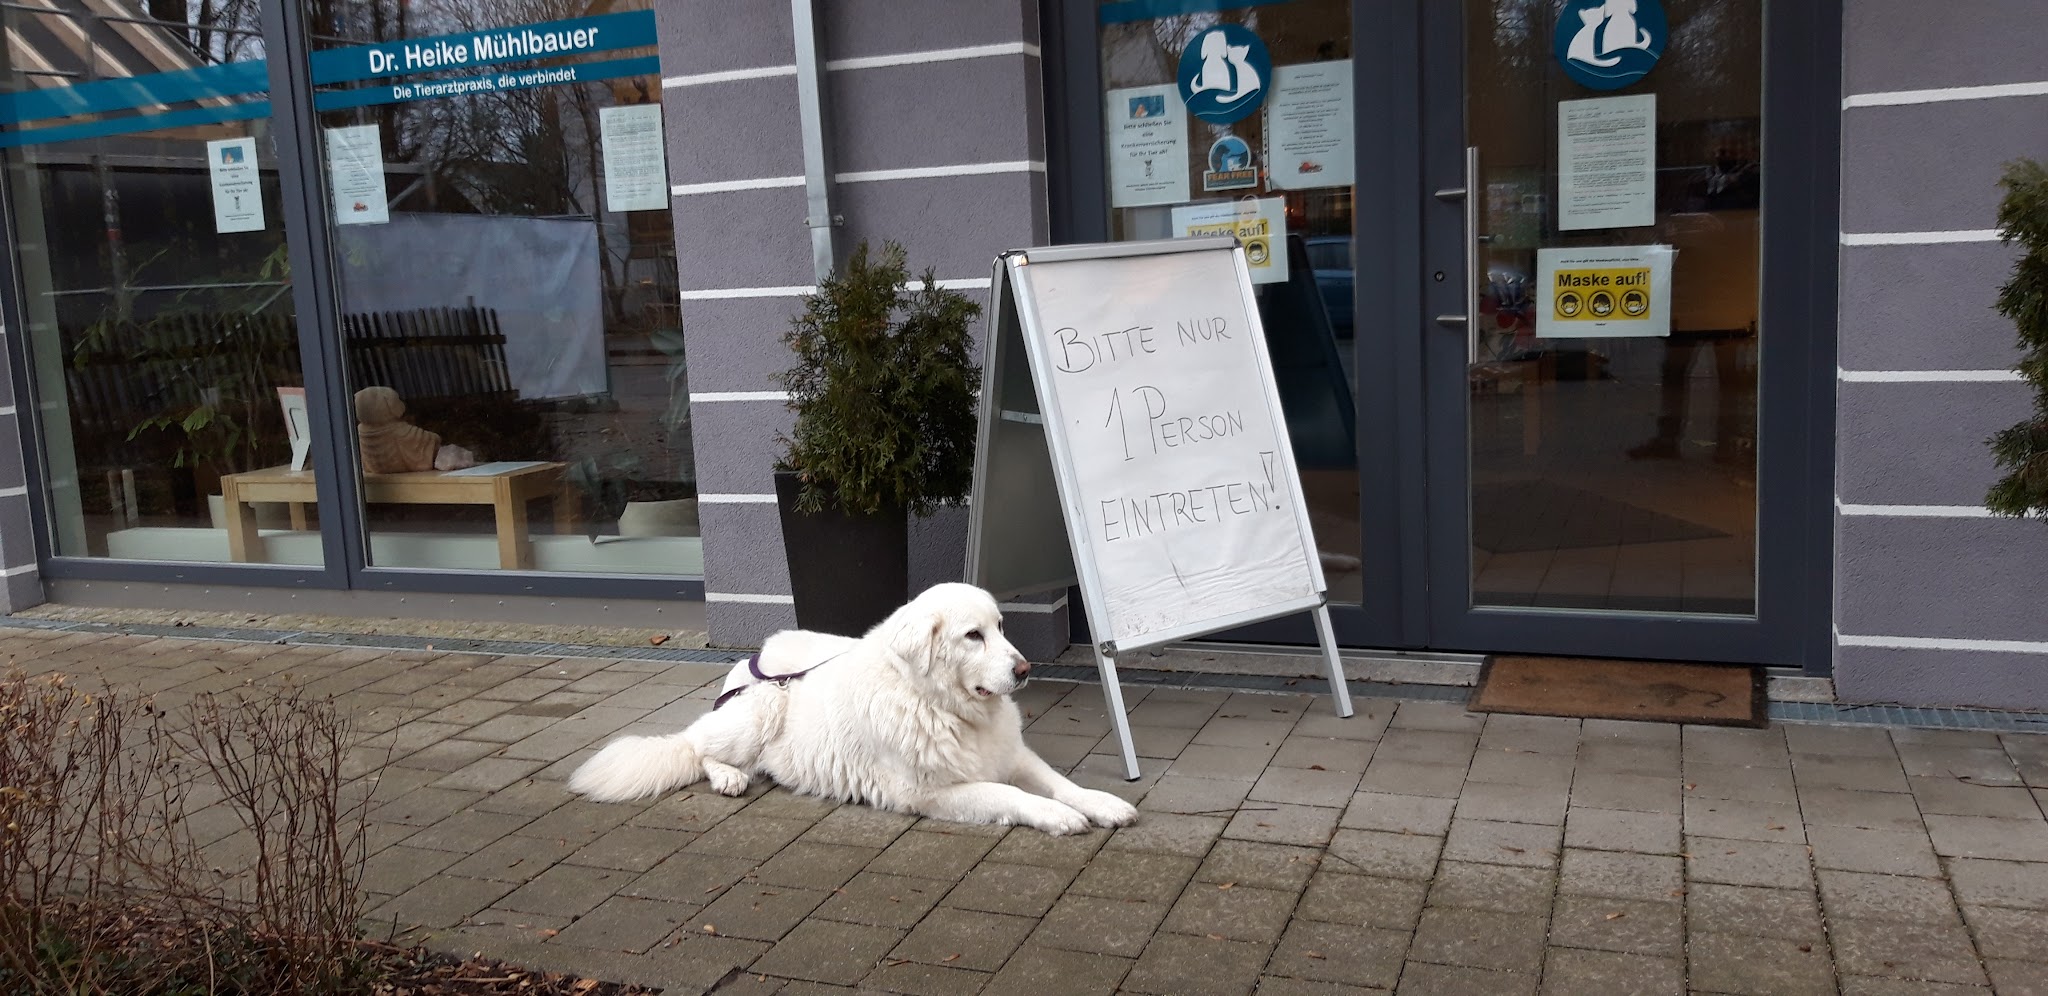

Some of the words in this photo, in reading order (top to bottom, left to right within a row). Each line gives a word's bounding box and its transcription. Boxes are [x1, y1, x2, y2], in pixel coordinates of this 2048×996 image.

[369, 49, 399, 74] Dr.
[405, 41, 468, 70] Heike
[474, 27, 599, 61] Mühlbauer
[393, 85, 412, 100] Die
[414, 77, 496, 98] Tierarztpraxis,
[498, 75, 517, 89] die
[518, 67, 577, 86] verbindet
[1558, 272, 1610, 287] Maske
[1054, 326, 1157, 374] BITTE
[1176, 317, 1232, 348] NUR
[1105, 387, 1135, 461] 1
[1132, 385, 1244, 455] PERSON
[1100, 451, 1281, 542] EINTRETEN!
